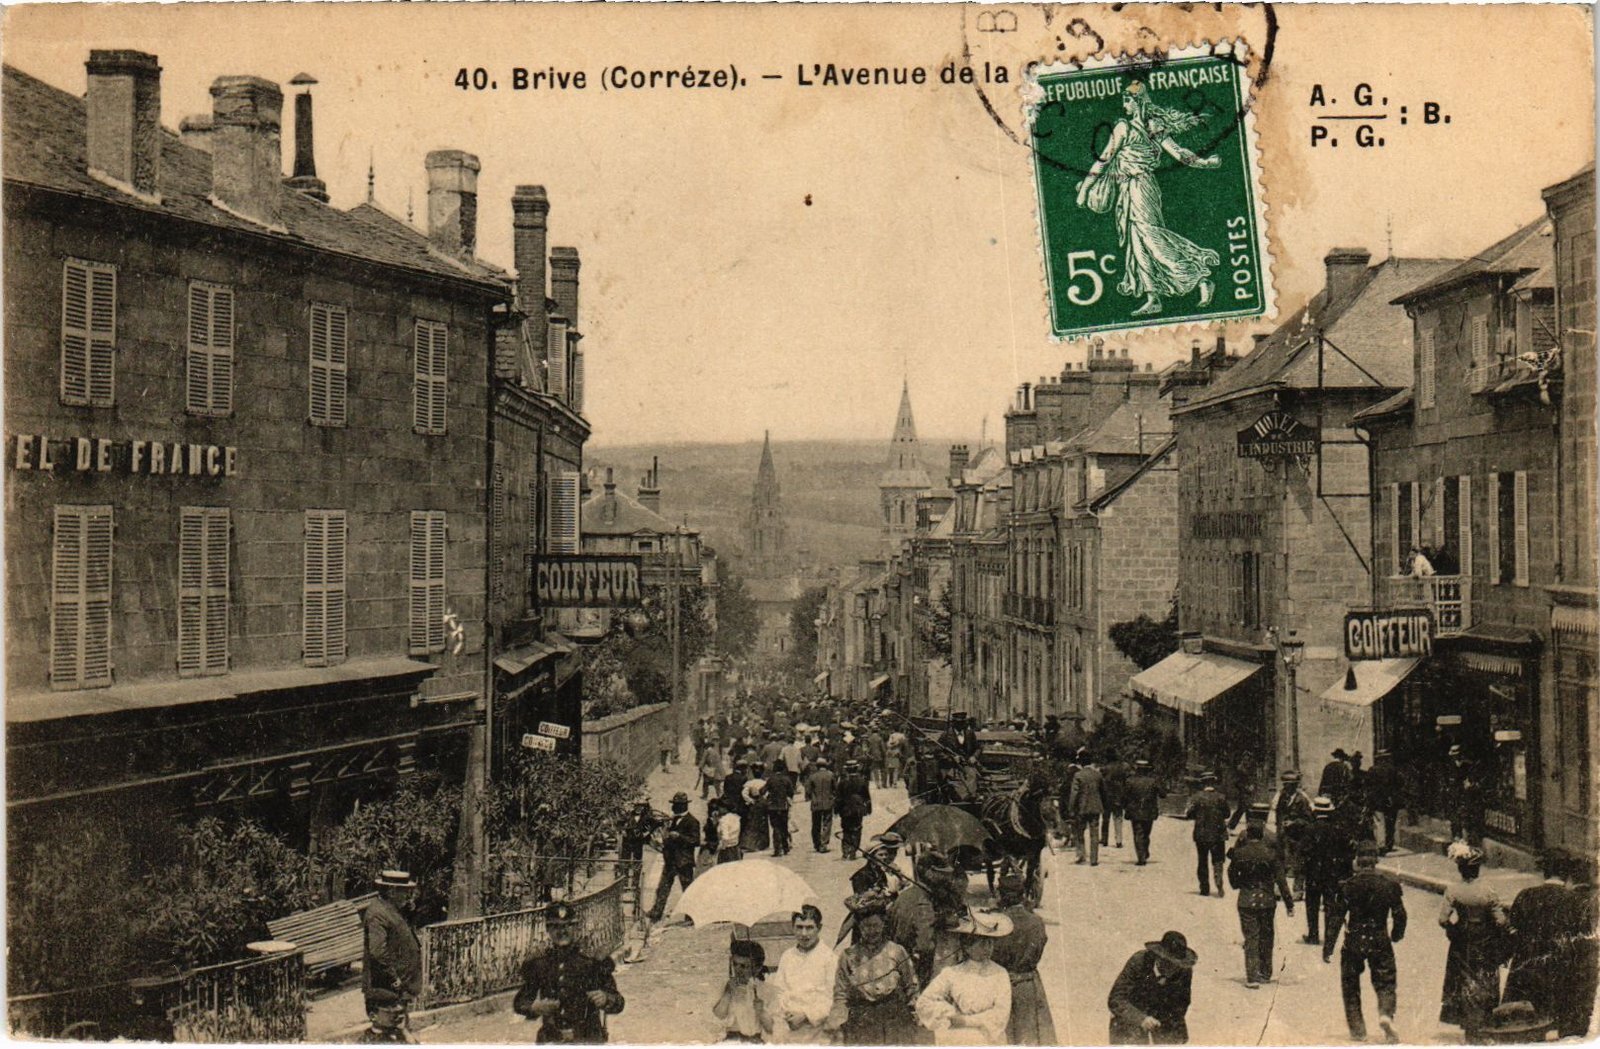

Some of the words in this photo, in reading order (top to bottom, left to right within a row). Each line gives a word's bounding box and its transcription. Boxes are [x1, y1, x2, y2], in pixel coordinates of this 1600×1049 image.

[1149, 64, 1230, 91] FRANÇAISE
[1227, 215, 1254, 300] POSTES
[76, 437, 113, 472] DE
[131, 440, 238, 476] FRANCE
[536, 561, 641, 600] COIFFEUR
[1348, 614, 1431, 656] COIFFEUR
